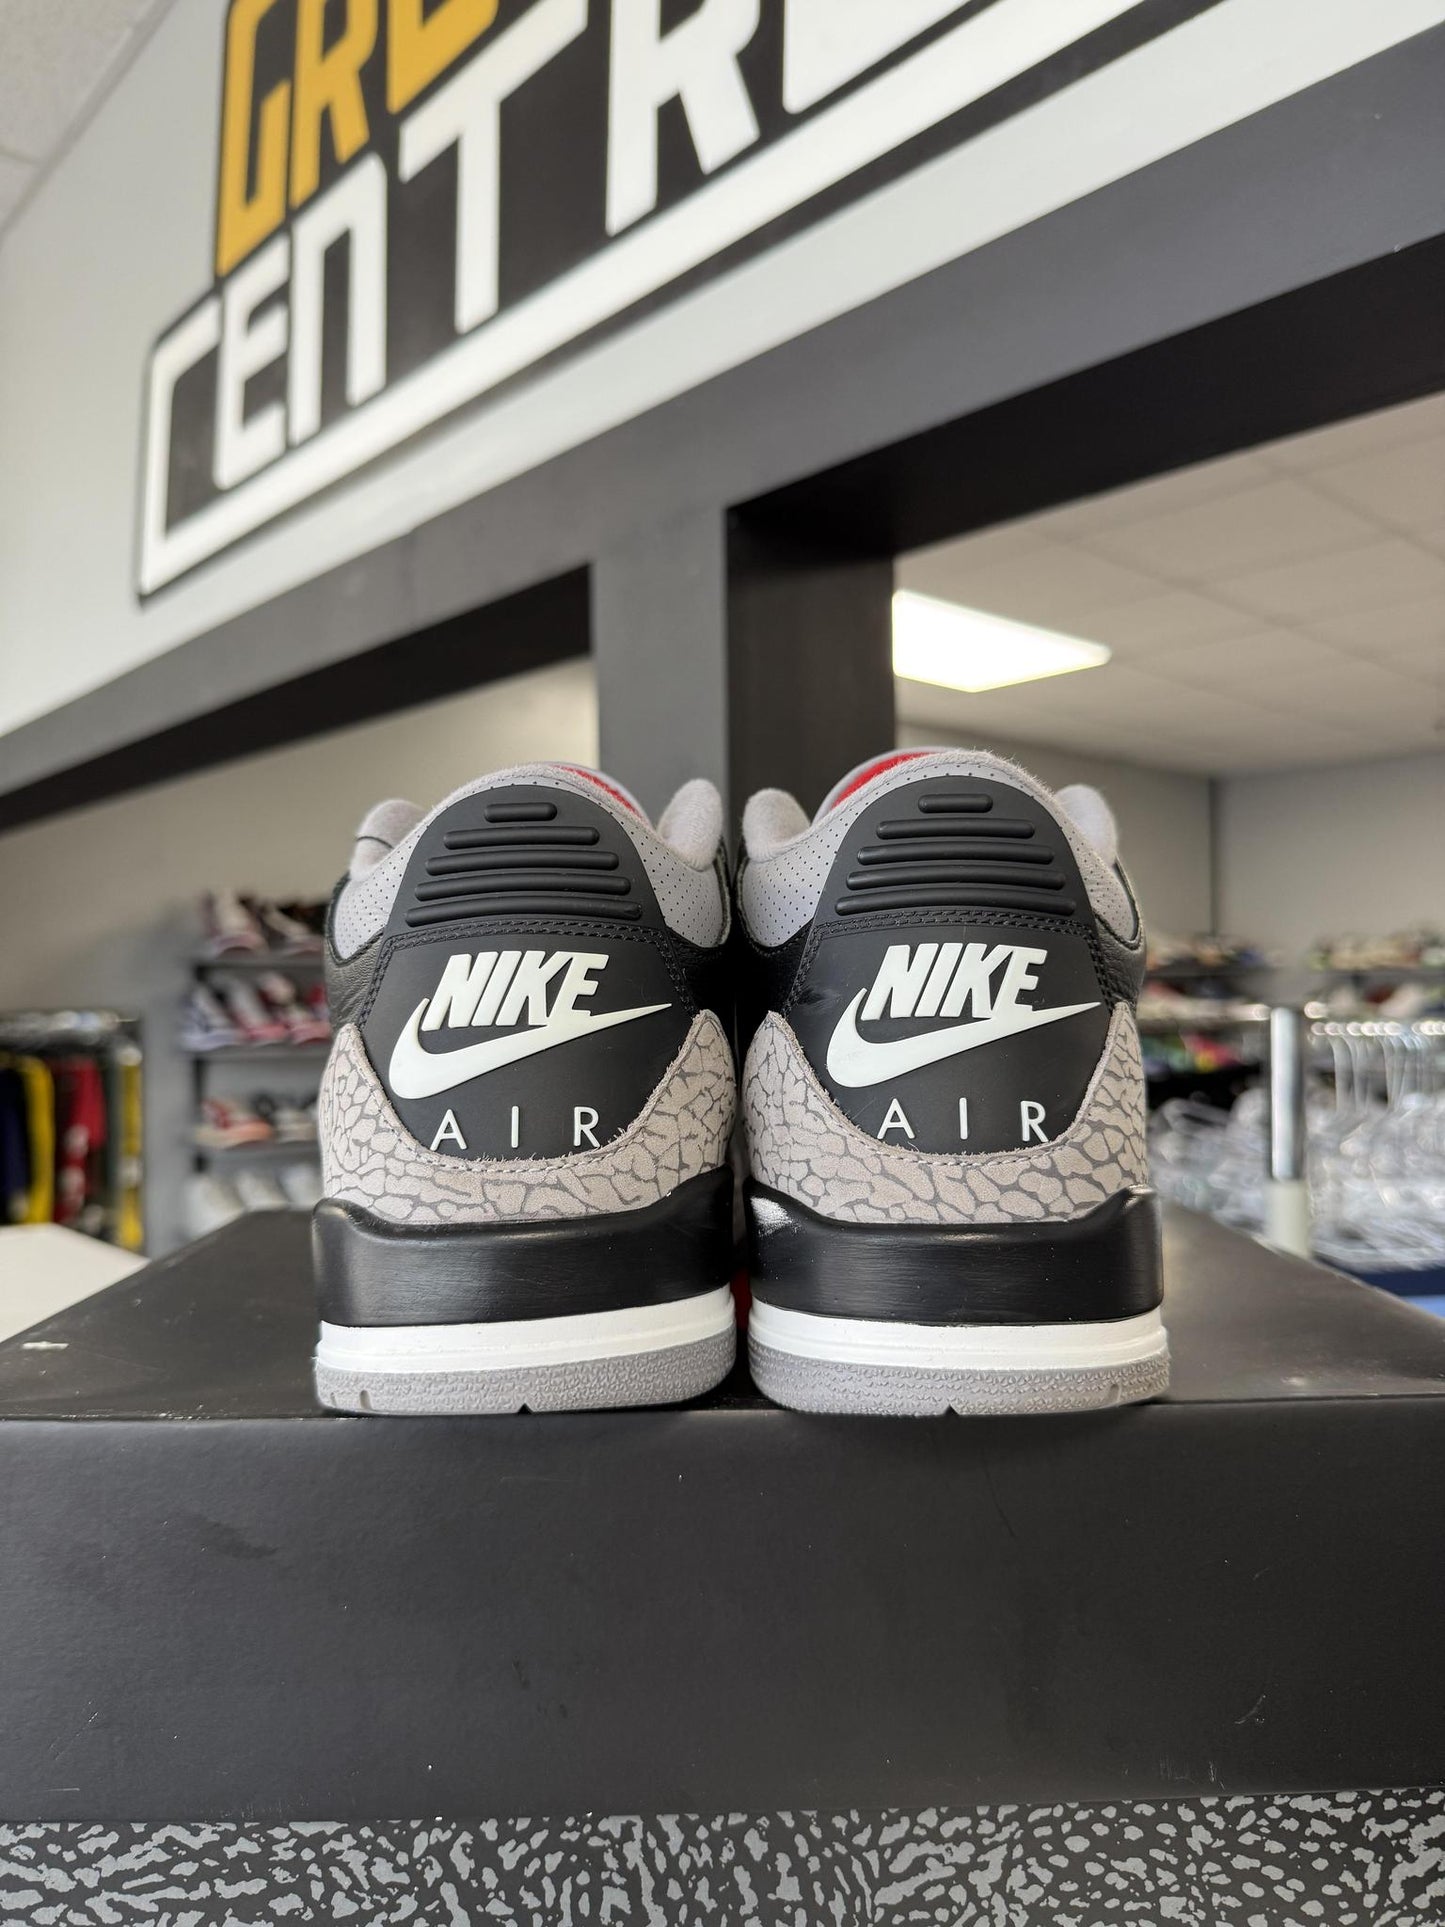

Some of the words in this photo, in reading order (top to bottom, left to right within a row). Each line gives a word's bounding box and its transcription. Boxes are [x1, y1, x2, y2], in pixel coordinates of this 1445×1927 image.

[420, 950, 610, 1032] NIKE
[860, 942, 1049, 1021] NIKE
[429, 1105, 602, 1151] AIR
[876, 1097, 1049, 1143] AIR
